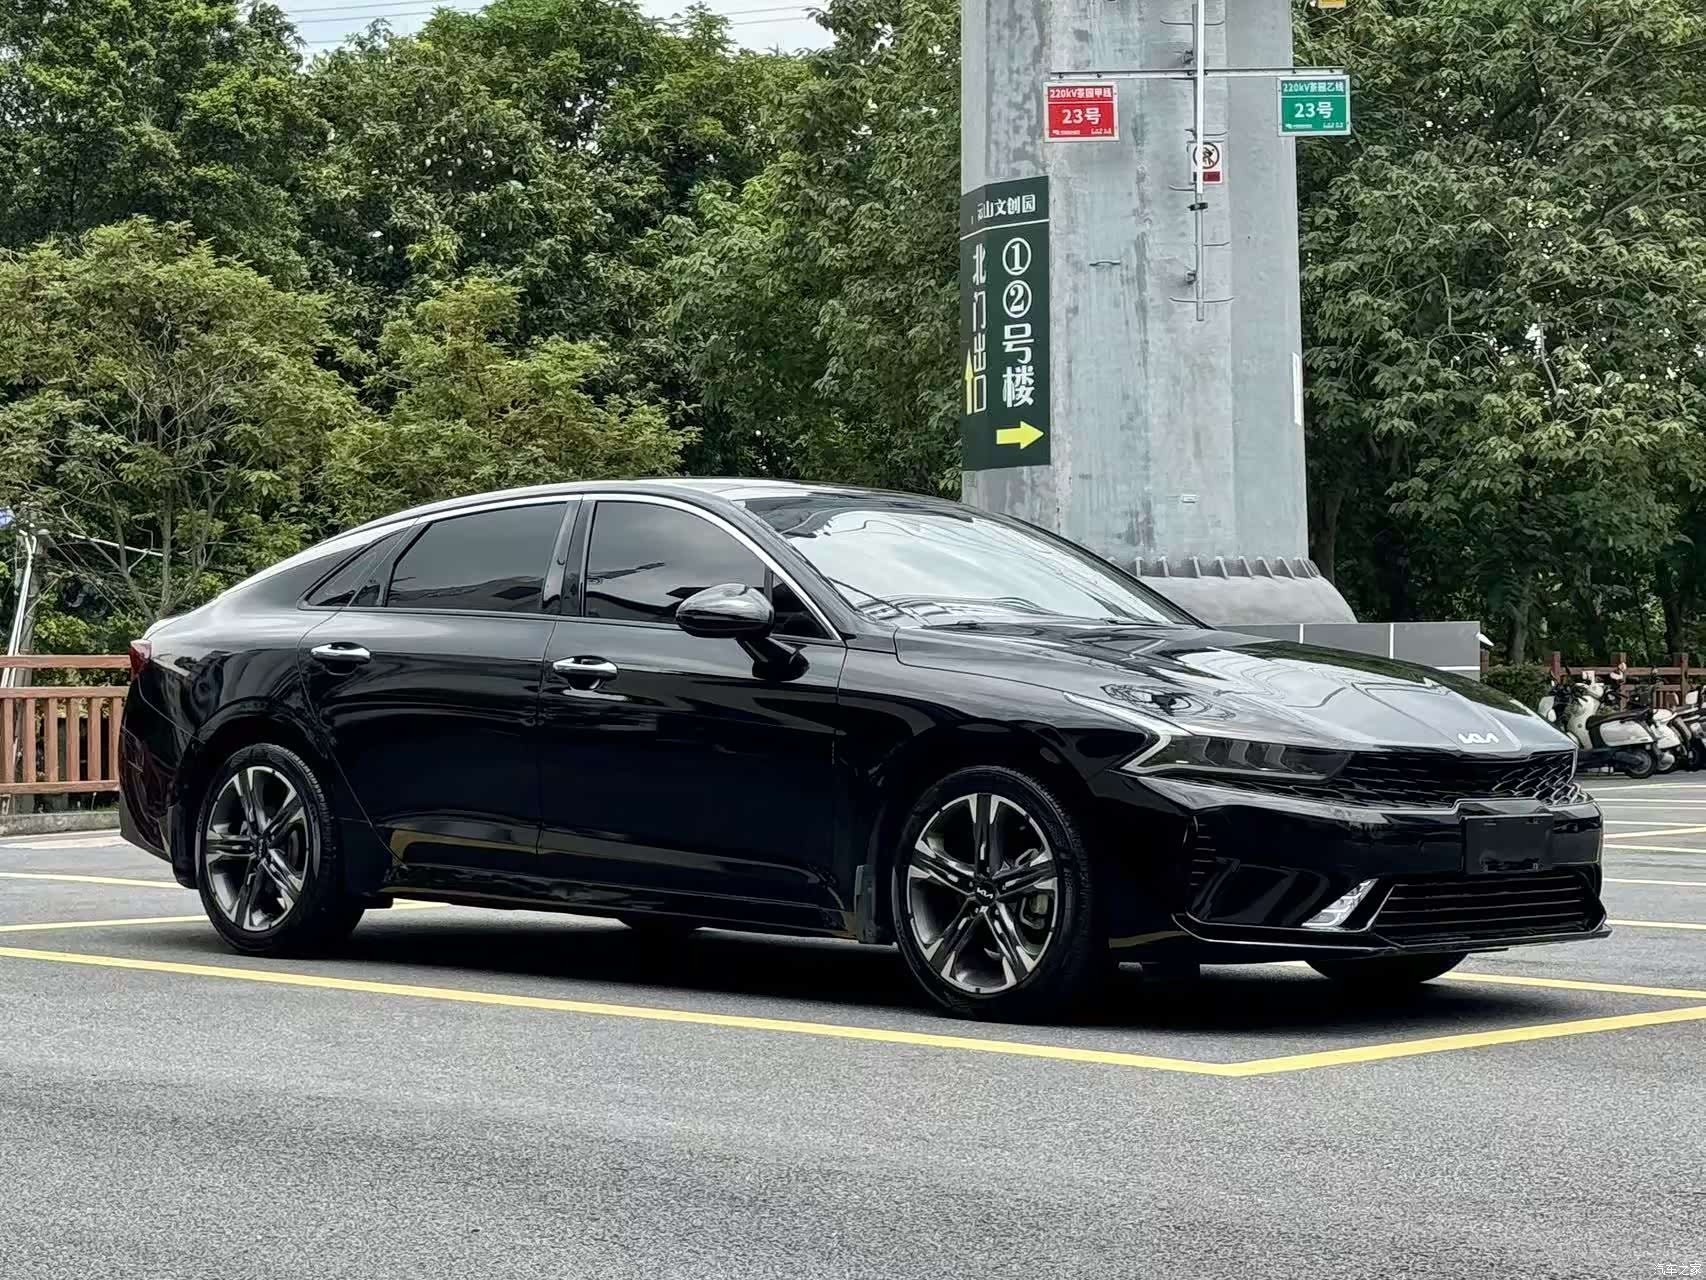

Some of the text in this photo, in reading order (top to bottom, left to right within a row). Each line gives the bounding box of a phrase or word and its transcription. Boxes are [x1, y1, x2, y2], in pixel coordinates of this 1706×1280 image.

[1062, 108, 1101, 125] 23号
[1295, 102, 1333, 119] 23号
[972, 243, 987, 413] 北门出口
